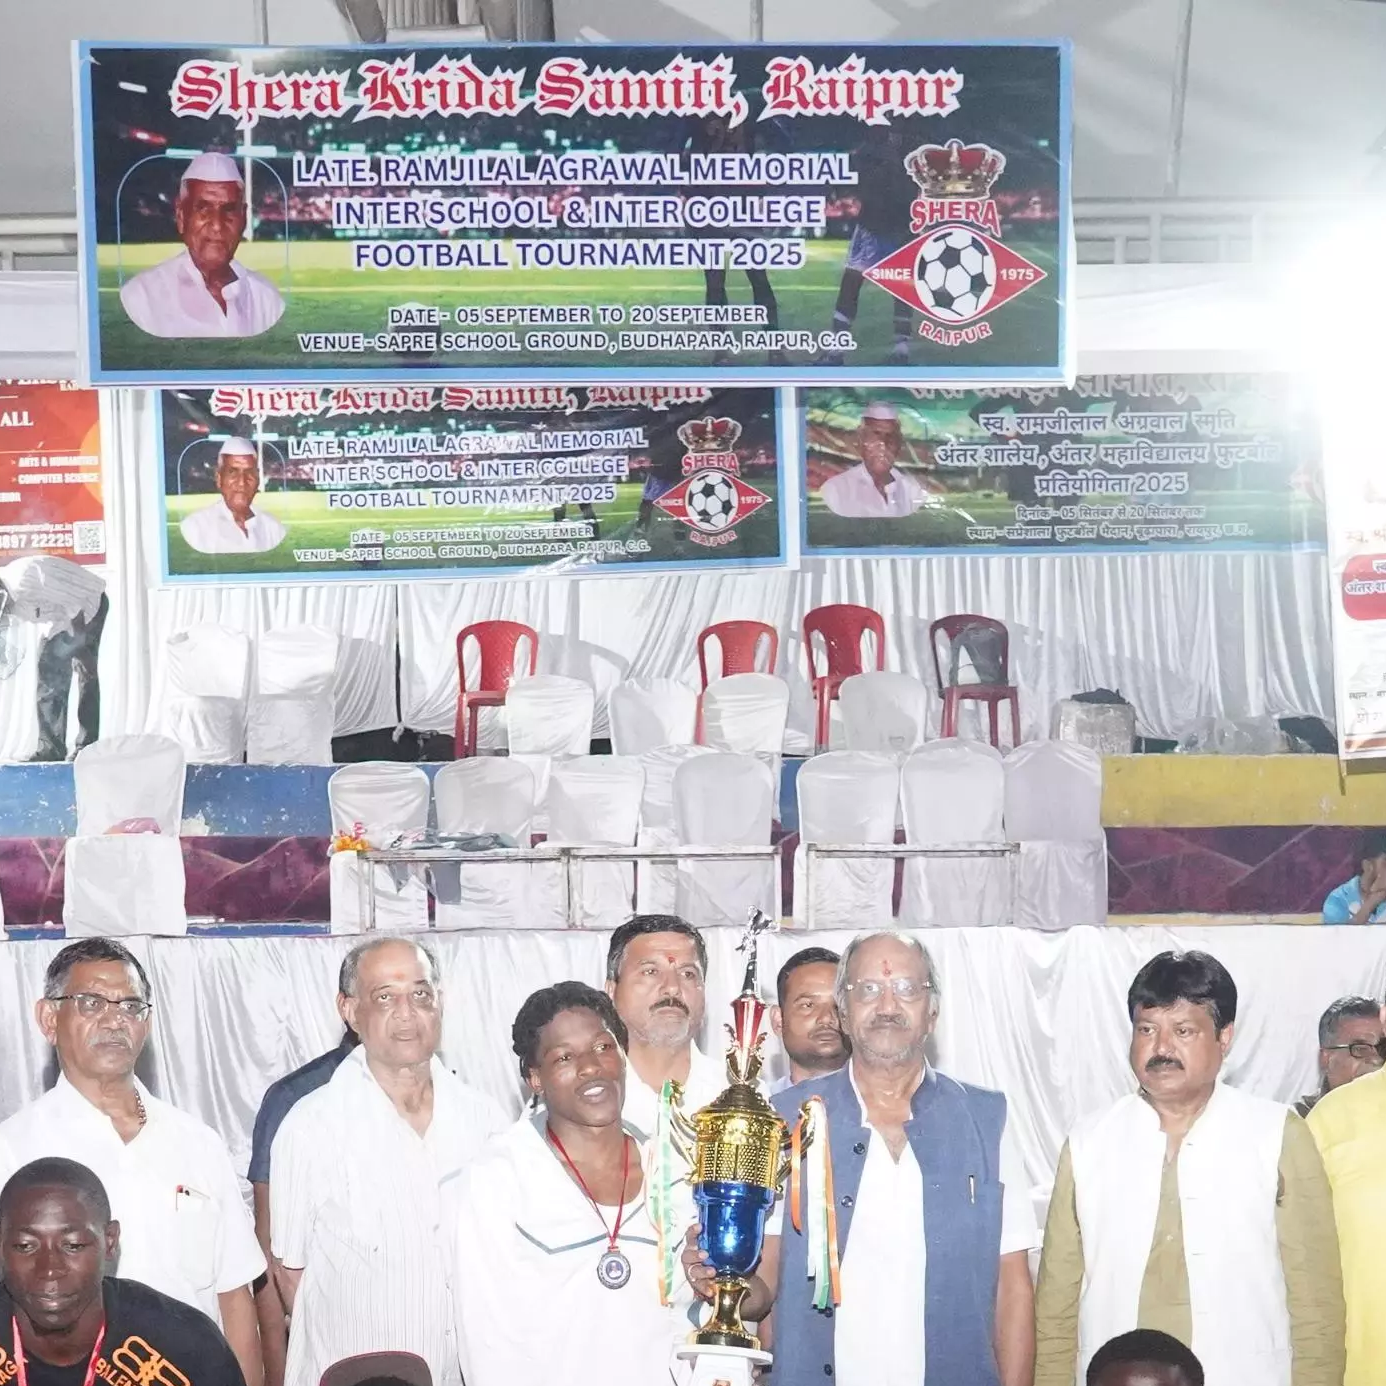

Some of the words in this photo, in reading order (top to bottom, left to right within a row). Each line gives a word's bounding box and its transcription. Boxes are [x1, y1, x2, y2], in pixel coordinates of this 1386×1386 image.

[174, 60, 346, 126] Shera
[359, 60, 521, 116] Krida
[537, 60, 746, 122] Samiti,
[767, 60, 959, 122] Raipur
[295, 157, 377, 184] LATE.
[383, 157, 531, 183] RAMJILAL
[538, 157, 686, 182] AGRAWAL
[693, 156, 854, 182] MEMORIAL
[334, 199, 420, 226] INTER
[427, 199, 552, 225] SCHOOL
[566, 199, 587, 224] &
[593, 199, 681, 224] INTER
[688, 198, 823, 224] COLLEGE
[910, 201, 1001, 238] SHERA
[355, 242, 509, 269] FOOTBALL
[516, 242, 731, 268] TOURNAMENT
[733, 241, 803, 267] 2025
[872, 268, 912, 280] SINCE
[1000, 268, 1035, 281] 1975
[456, 308, 480, 325] 05
[483, 307, 591, 325] SEPTEMBER
[599, 307, 624, 323] TO
[631, 307, 654, 324] 20
[658, 306, 767, 323] SEPTEMBER
[442, 333, 519, 350] SCHOOL
[620, 333, 740, 352] BUDHAPARA,
[743, 333, 816, 352] RAIPUR,
[819, 333, 855, 350] C.G.
[919, 321, 993, 345] RAIPUR
[0, 410, 34, 428] ALL
[980, 414, 1010, 434] स्व.
[1014, 409, 1109, 433] रामजीलाल
[1116, 412, 1186, 433] अग्रवाल
[1191, 410, 1237, 437] स्मृति
[290, 440, 344, 458] LATE.
[347, 437, 441, 456] RAMJILAL
[445, 435, 540, 454] AGRAWAL
[542, 430, 649, 450] MEMORIAL
[935, 442, 977, 465] अंतर
[1049, 442, 1095, 465] अंतर
[1099, 441, 1209, 468] महाविद्यालय
[315, 464, 371, 484] INTER
[375, 462, 453, 481] SCHOOL
[462, 462, 476, 479] &
[480, 461, 535, 479] INTER
[537, 458, 627, 477] COLLEGE
[681, 453, 740, 477] SHERA
[1035, 471, 1132, 496] प्रतियोगिता
[1134, 473, 1189, 495] 2025
[328, 491, 427, 509] FOOTBALL
[431, 487, 572, 506] TOURNAMENT
[571, 484, 616, 501] 2025
[1060, 507, 1077, 520] 05
[1130, 507, 1146, 519] 20
[393, 530, 410, 543] 05
[412, 528, 481, 542] SEPTEMBER
[485, 528, 501, 541] TO
[505, 528, 522, 540] 20
[523, 526, 594, 540] SEPTEMBER
[689, 530, 739, 546] RAIPUR
[384, 546, 436, 560] SCHOOL
